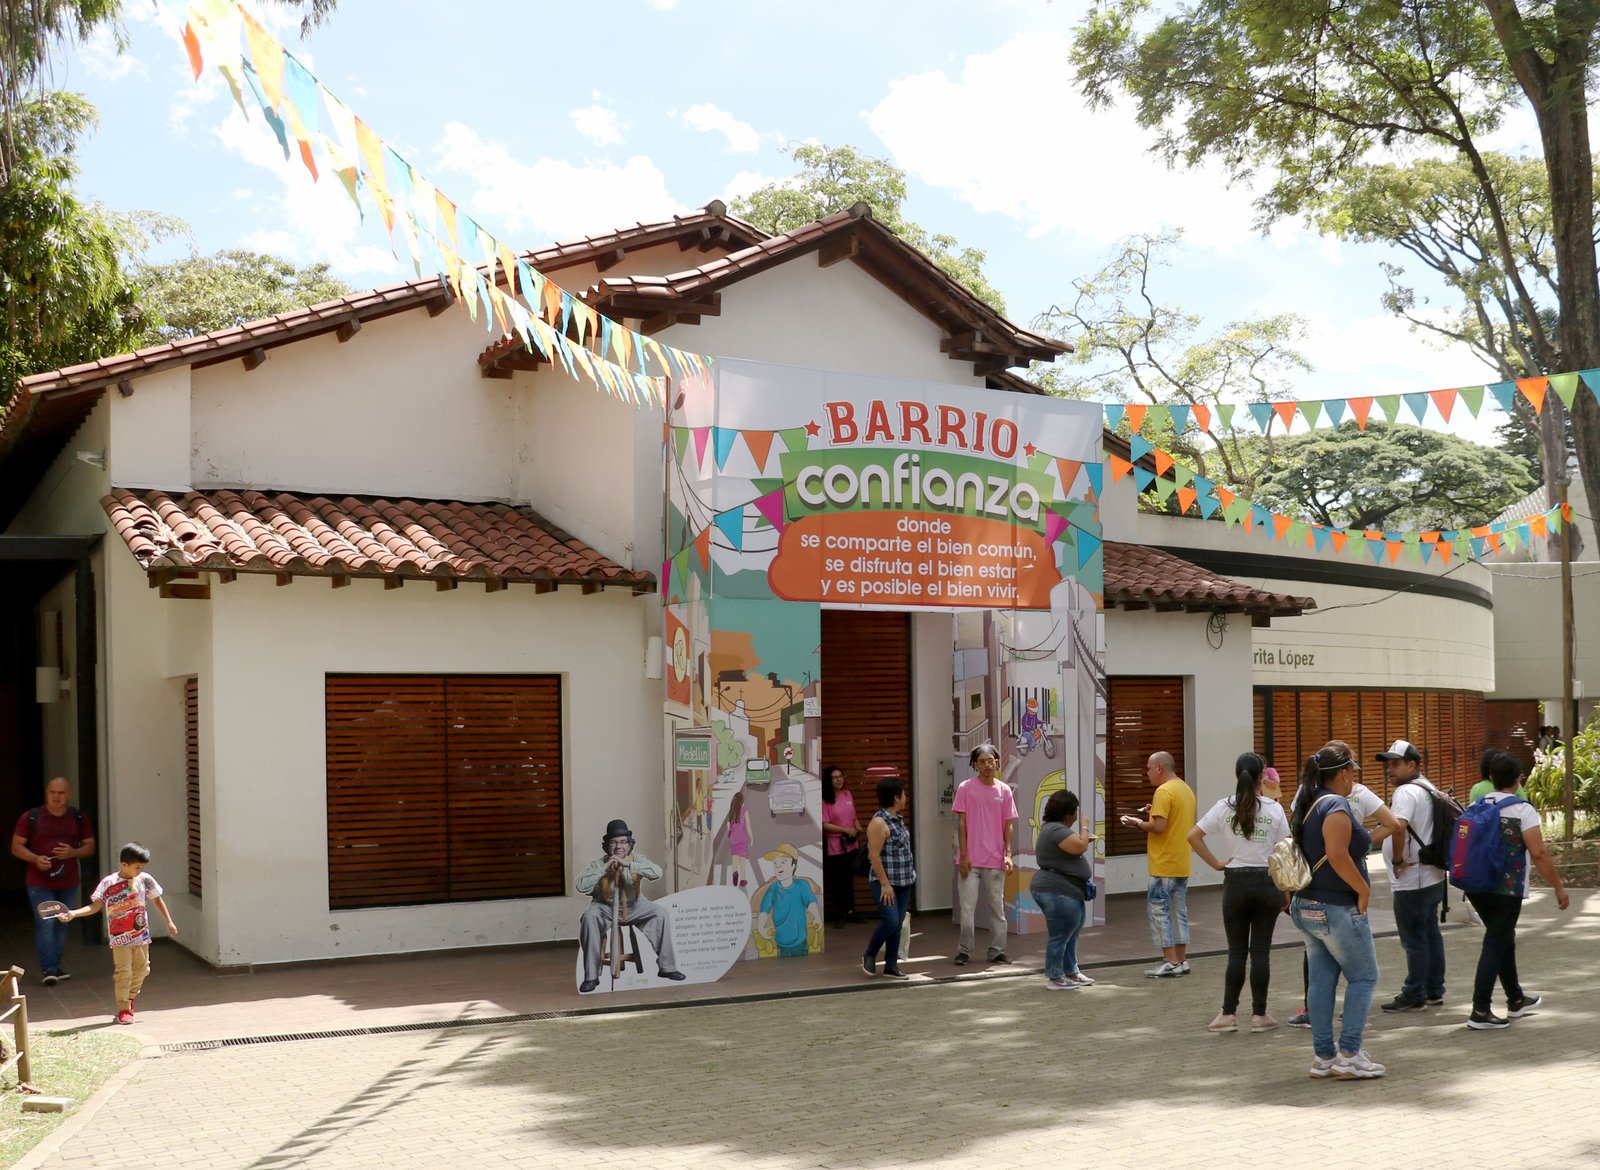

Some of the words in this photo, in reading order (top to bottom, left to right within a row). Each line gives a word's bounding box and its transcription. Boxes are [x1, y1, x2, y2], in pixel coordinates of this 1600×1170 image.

[823, 399, 1019, 460] BARRIO
[796, 453, 1041, 522] confianza
[896, 516, 951, 534] donde
[800, 534, 820, 548] se
[825, 535, 912, 554] comparte
[917, 538, 932, 553] el
[937, 538, 973, 555] bien
[977, 541, 1037, 561] común,
[825, 558, 845, 572] se
[849, 556, 913, 575] disfruta
[918, 559, 933, 576] el
[938, 560, 974, 577] bien
[978, 563, 1017, 579] estar
[820, 579, 831, 596] y
[836, 579, 856, 593] es
[860, 578, 922, 597] posible
[927, 580, 942, 596] el
[947, 580, 983, 597] bien
[986, 583, 1020, 599] vivir.
[1278, 649, 1315, 669] López
